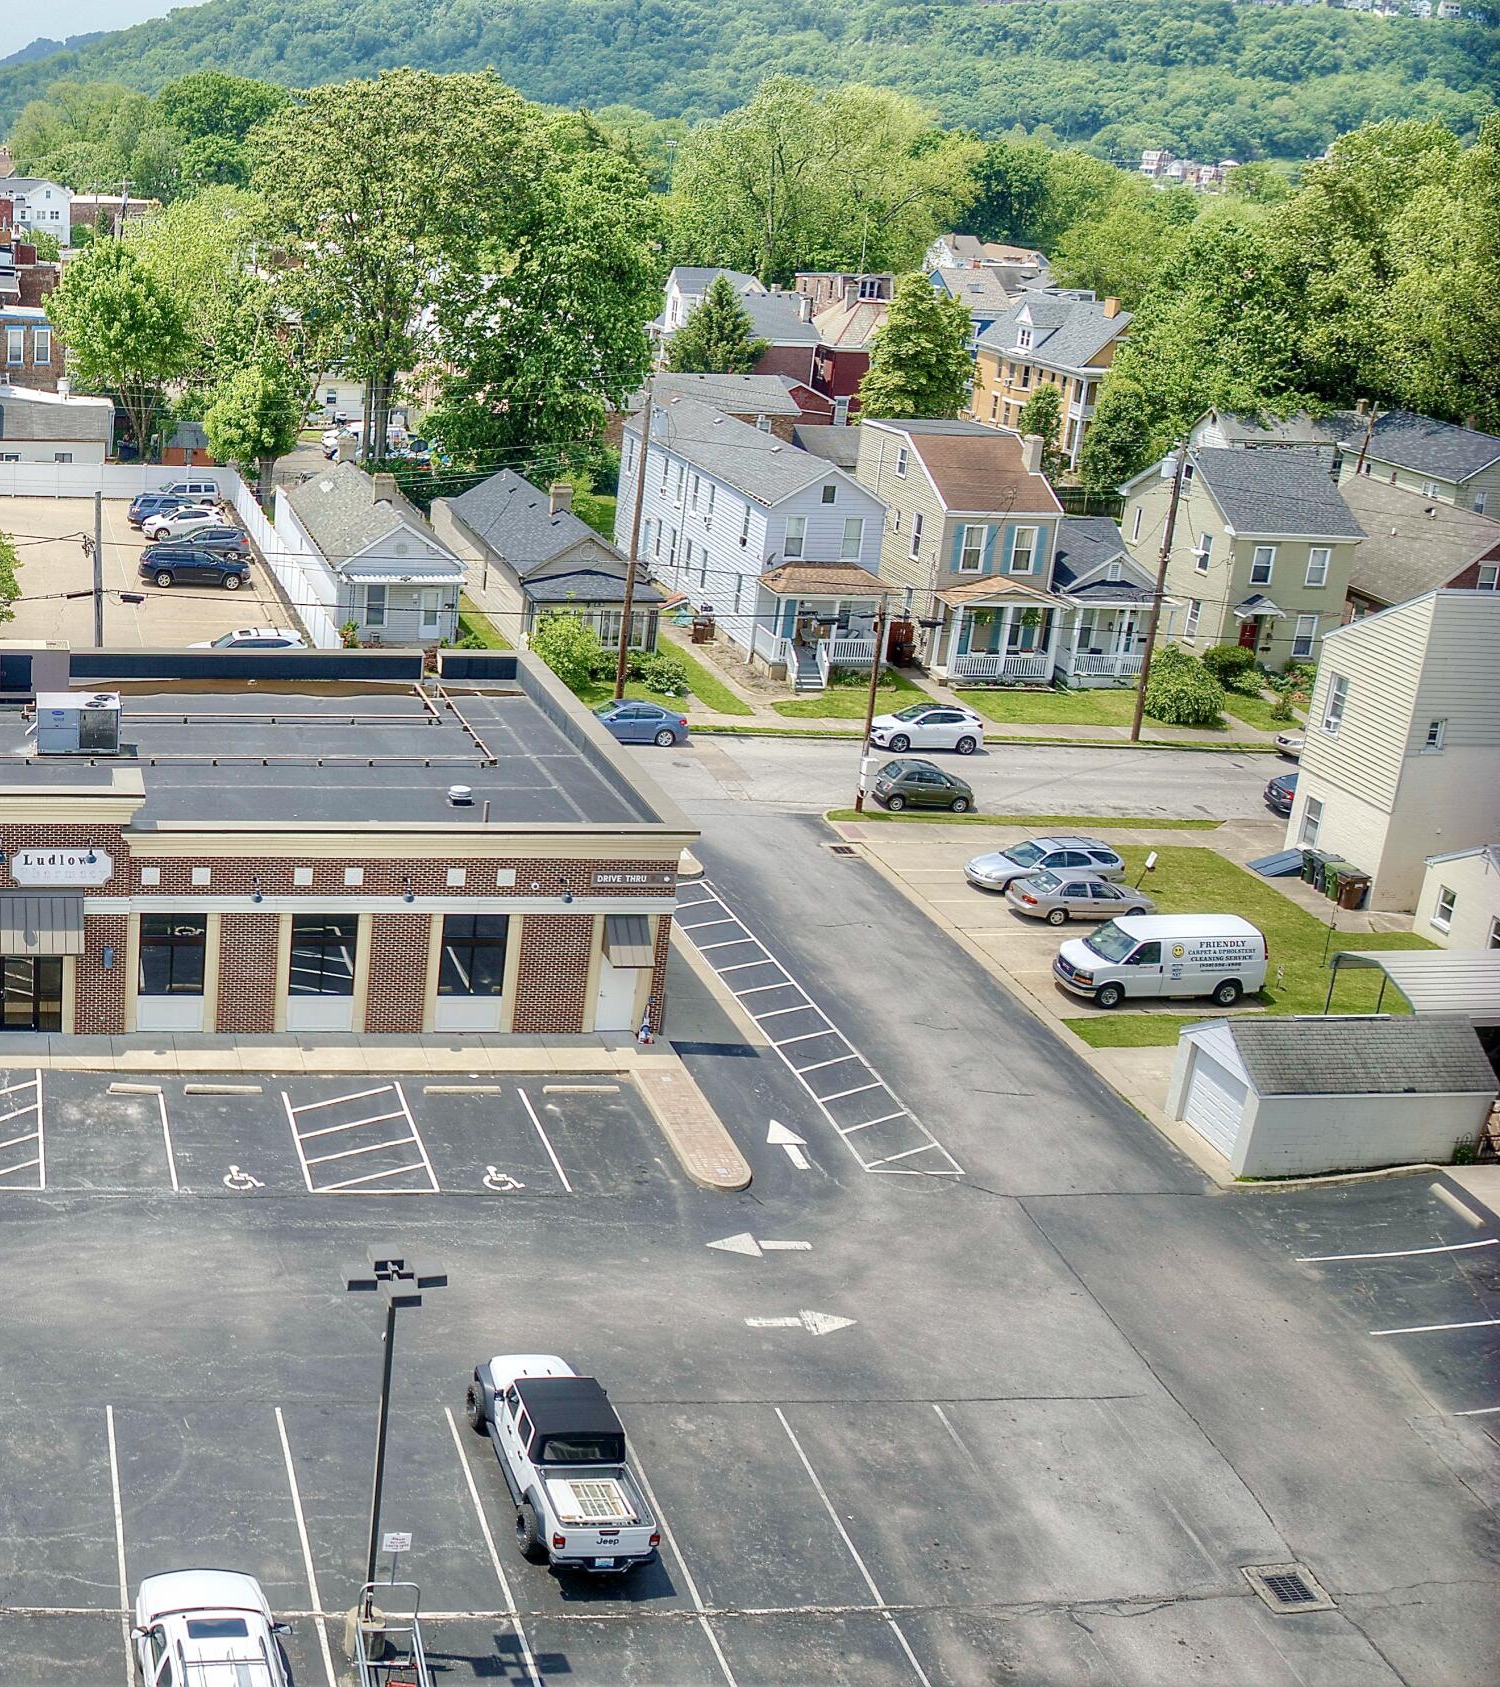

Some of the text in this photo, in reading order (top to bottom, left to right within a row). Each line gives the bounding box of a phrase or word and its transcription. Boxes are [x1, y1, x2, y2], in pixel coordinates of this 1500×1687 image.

[597, 875, 647, 883] DRIVE THRU
[1199, 940, 1247, 948] FRIENDLY
[596, 1537, 620, 1546] Jeep
